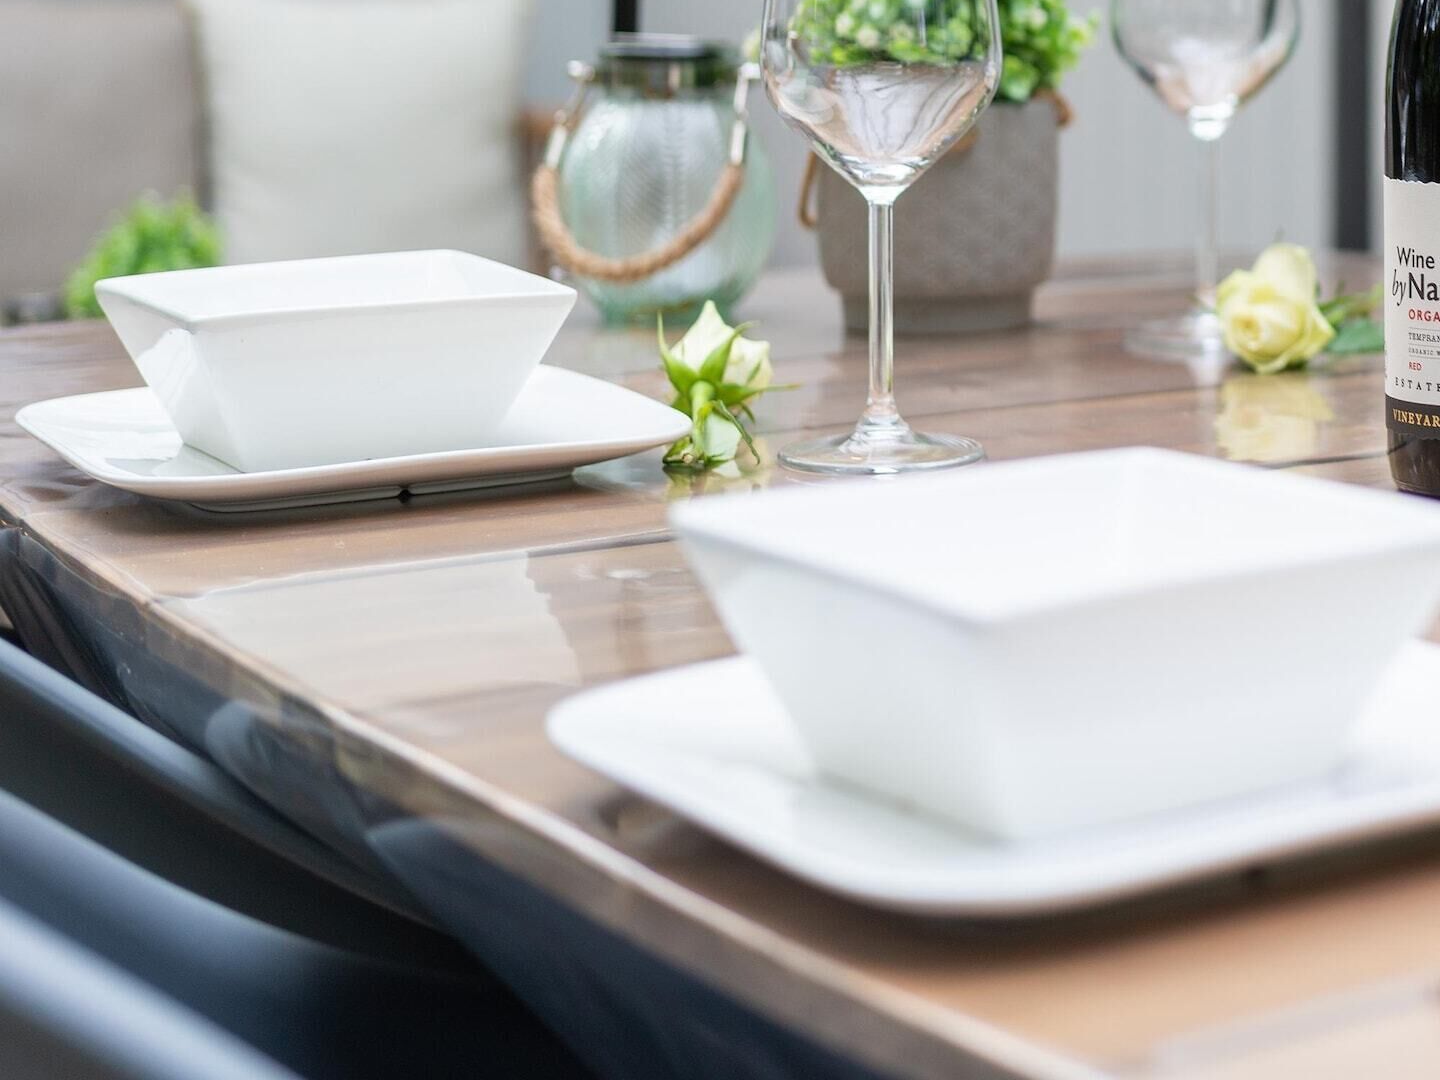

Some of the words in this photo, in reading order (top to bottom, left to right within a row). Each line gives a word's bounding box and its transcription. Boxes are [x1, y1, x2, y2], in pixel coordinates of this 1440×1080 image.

[1396, 245, 1435, 269] Wine
[1391, 268, 1406, 306] by
[1408, 361, 1422, 371] RED
